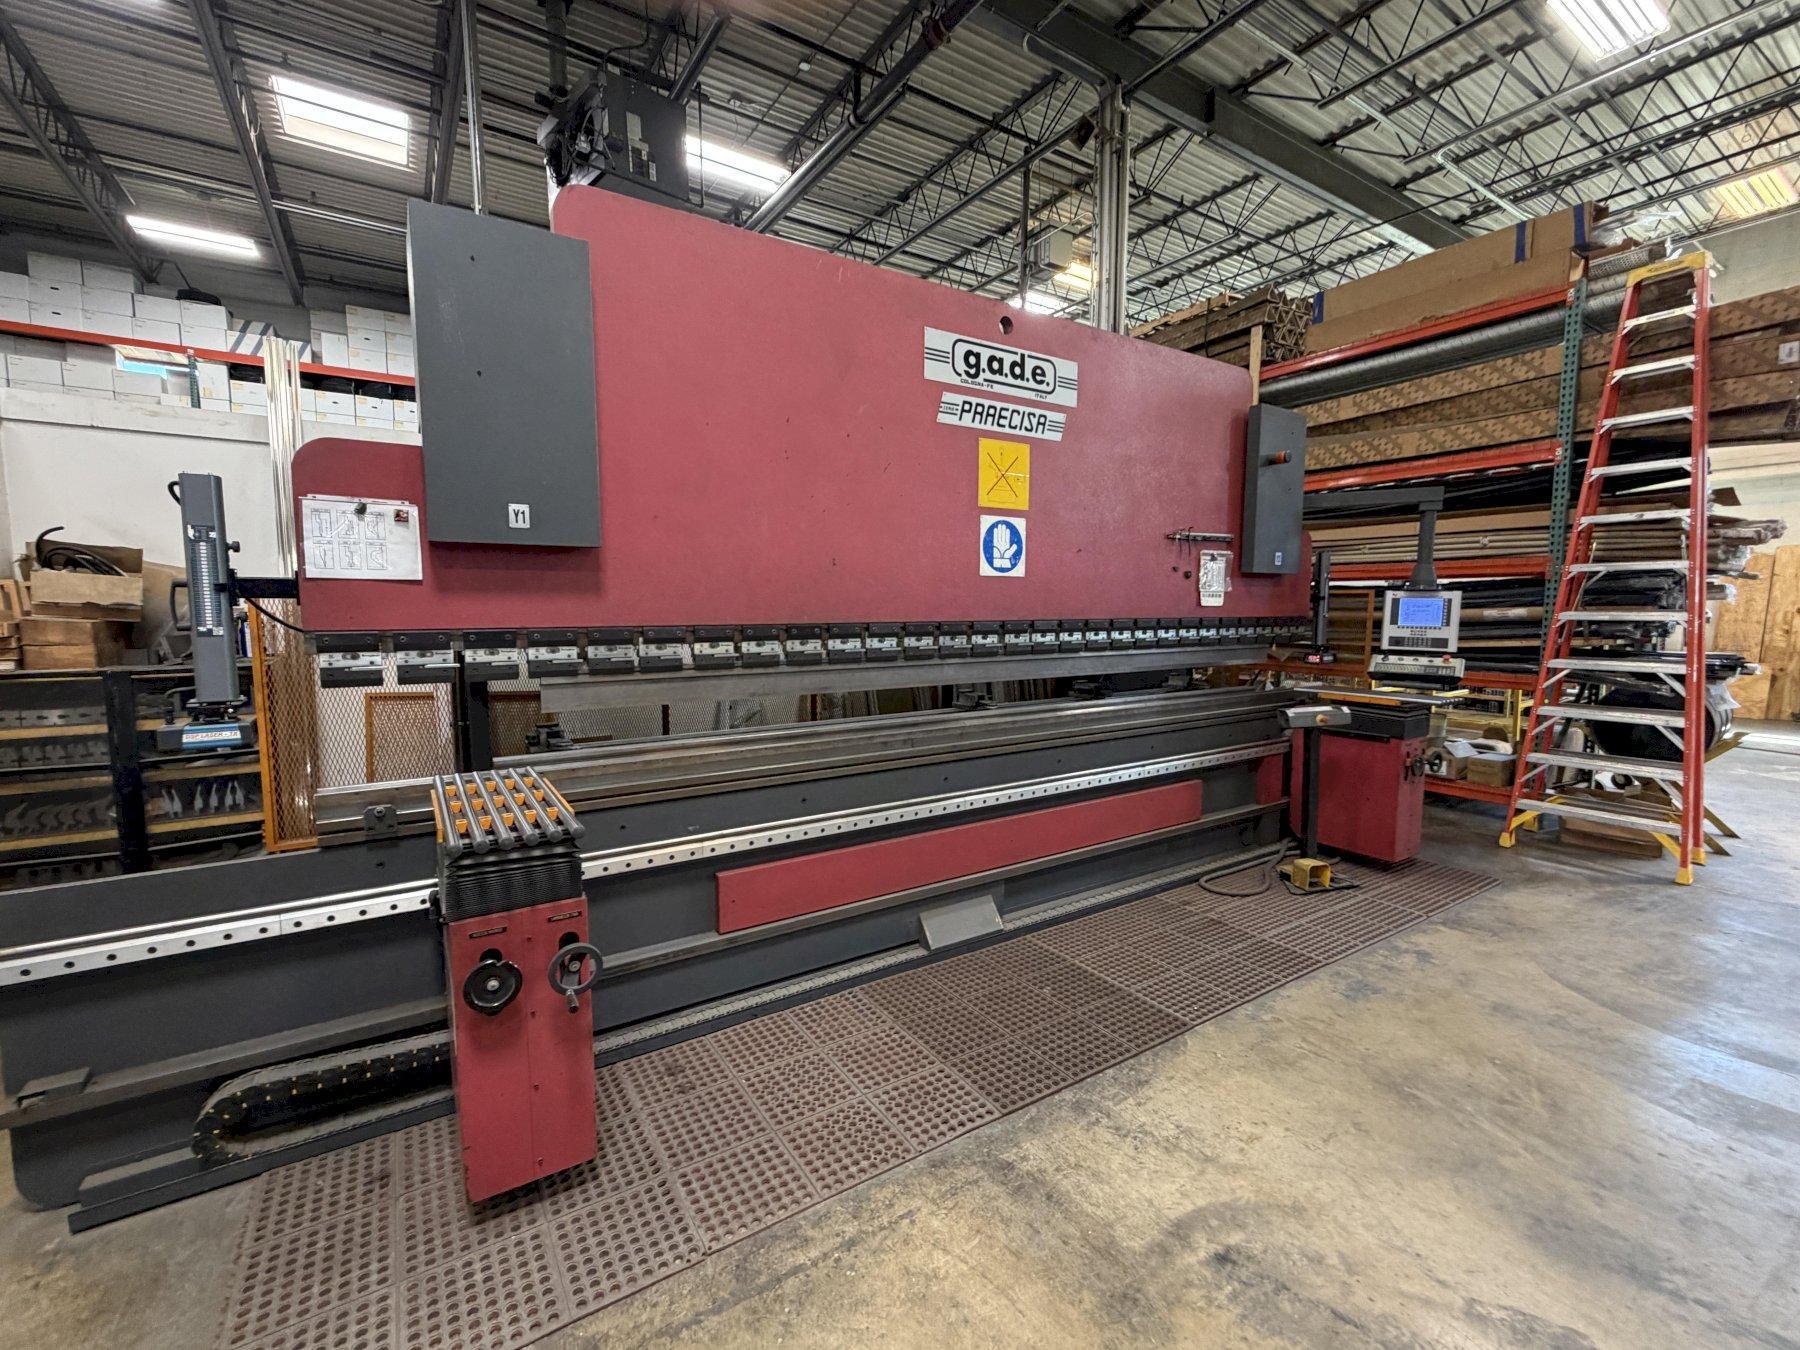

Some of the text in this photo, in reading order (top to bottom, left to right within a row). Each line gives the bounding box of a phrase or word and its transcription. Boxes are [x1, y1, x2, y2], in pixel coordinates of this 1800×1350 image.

[963, 349, 1050, 387] g.a.d.e.
[959, 400, 1047, 434] PRAECISA
[512, 508, 526, 524] Y1
